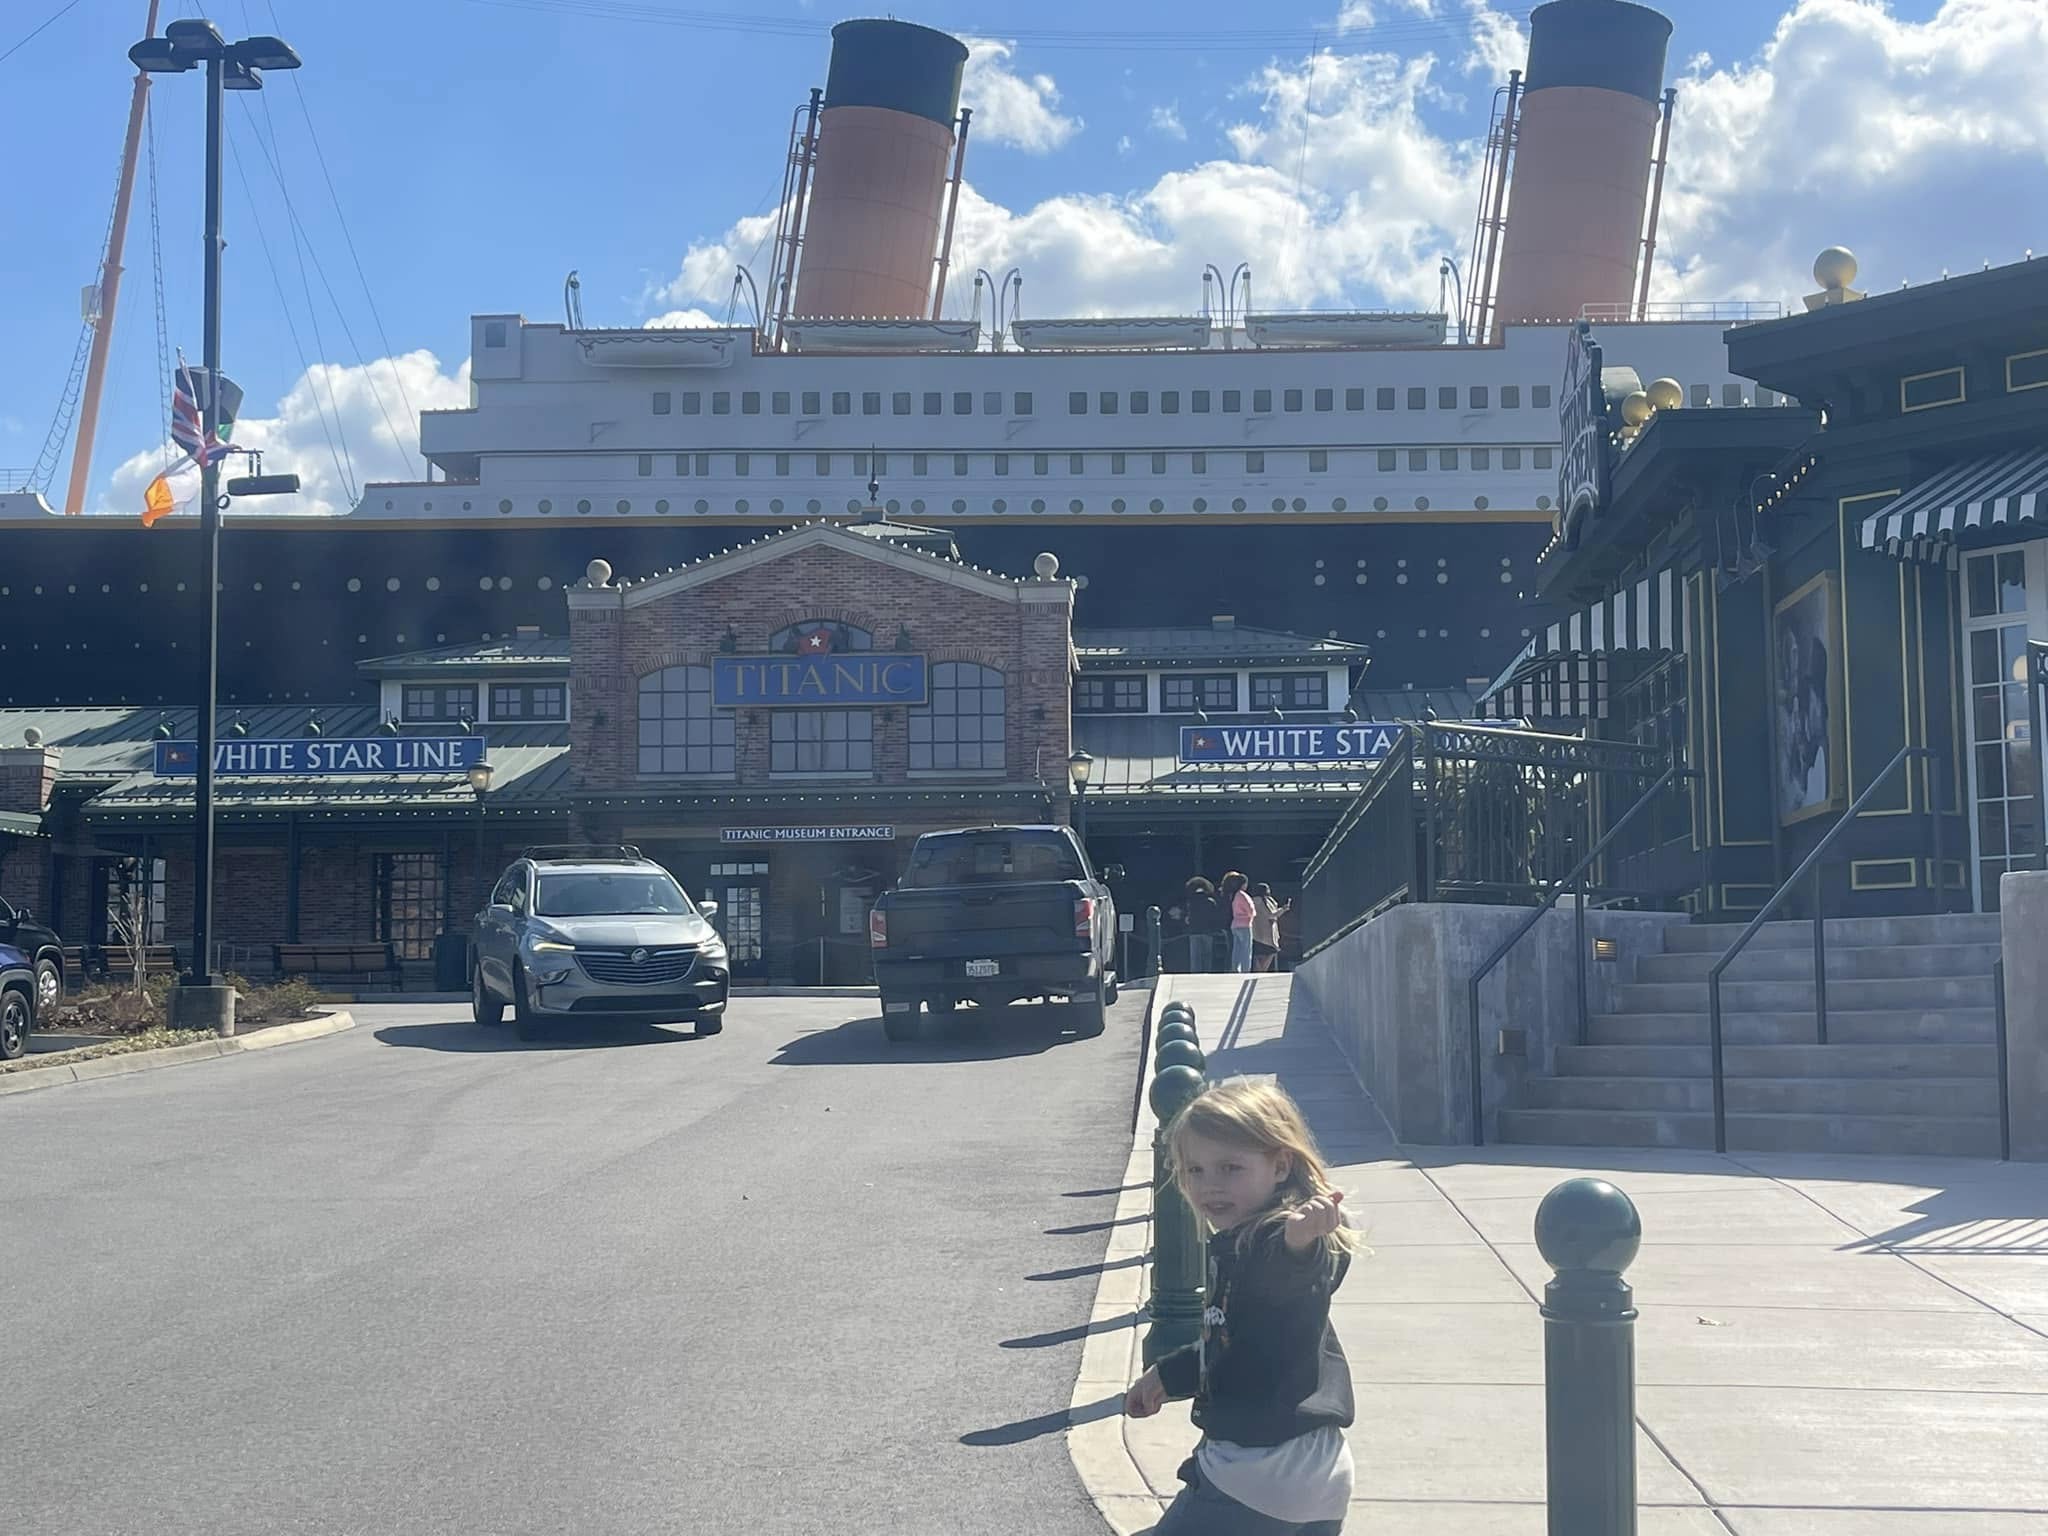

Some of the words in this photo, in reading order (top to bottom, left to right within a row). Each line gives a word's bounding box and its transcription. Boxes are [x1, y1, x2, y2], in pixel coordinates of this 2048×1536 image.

[726, 662, 913, 696] TITANIC
[196, 744, 295, 770] HITE
[307, 743, 384, 769] STAR
[395, 741, 464, 767] LINE
[1222, 730, 1325, 757] WHITE
[1336, 728, 1403, 755] STA
[725, 829, 771, 840] TITANIC
[775, 828, 826, 839] MUSEUM
[829, 827, 891, 838] ENTRANCE
